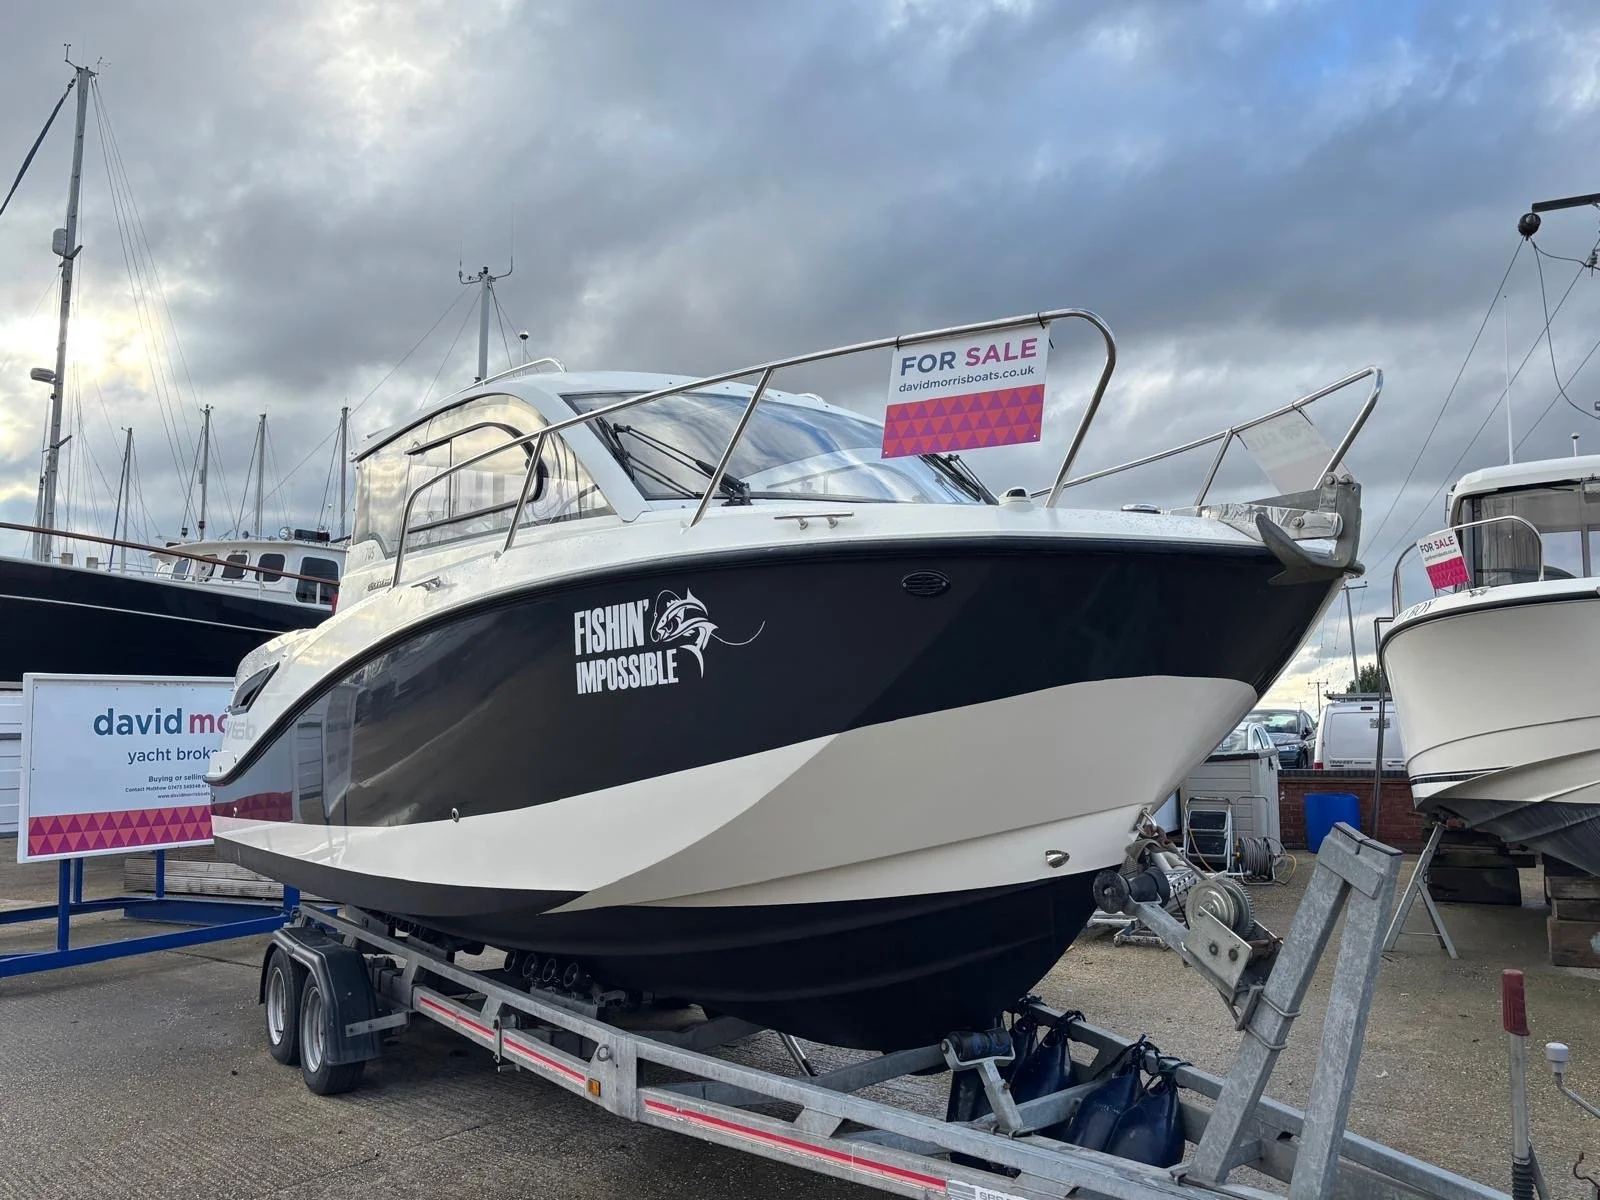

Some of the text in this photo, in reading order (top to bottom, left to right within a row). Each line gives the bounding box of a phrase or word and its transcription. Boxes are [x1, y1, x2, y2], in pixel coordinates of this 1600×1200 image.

[900, 337, 1038, 376] FOR SALE
[898, 365, 1035, 393] davidmorrisboats.co.uk
[1419, 536, 1454, 553] FOR SALE
[574, 598, 649, 656] FISHIN'
[576, 648, 679, 695] IMPOSSIBLE
[93, 707, 182, 736] david
[127, 747, 172, 765] yacht
[148, 775, 173, 783] Buying
